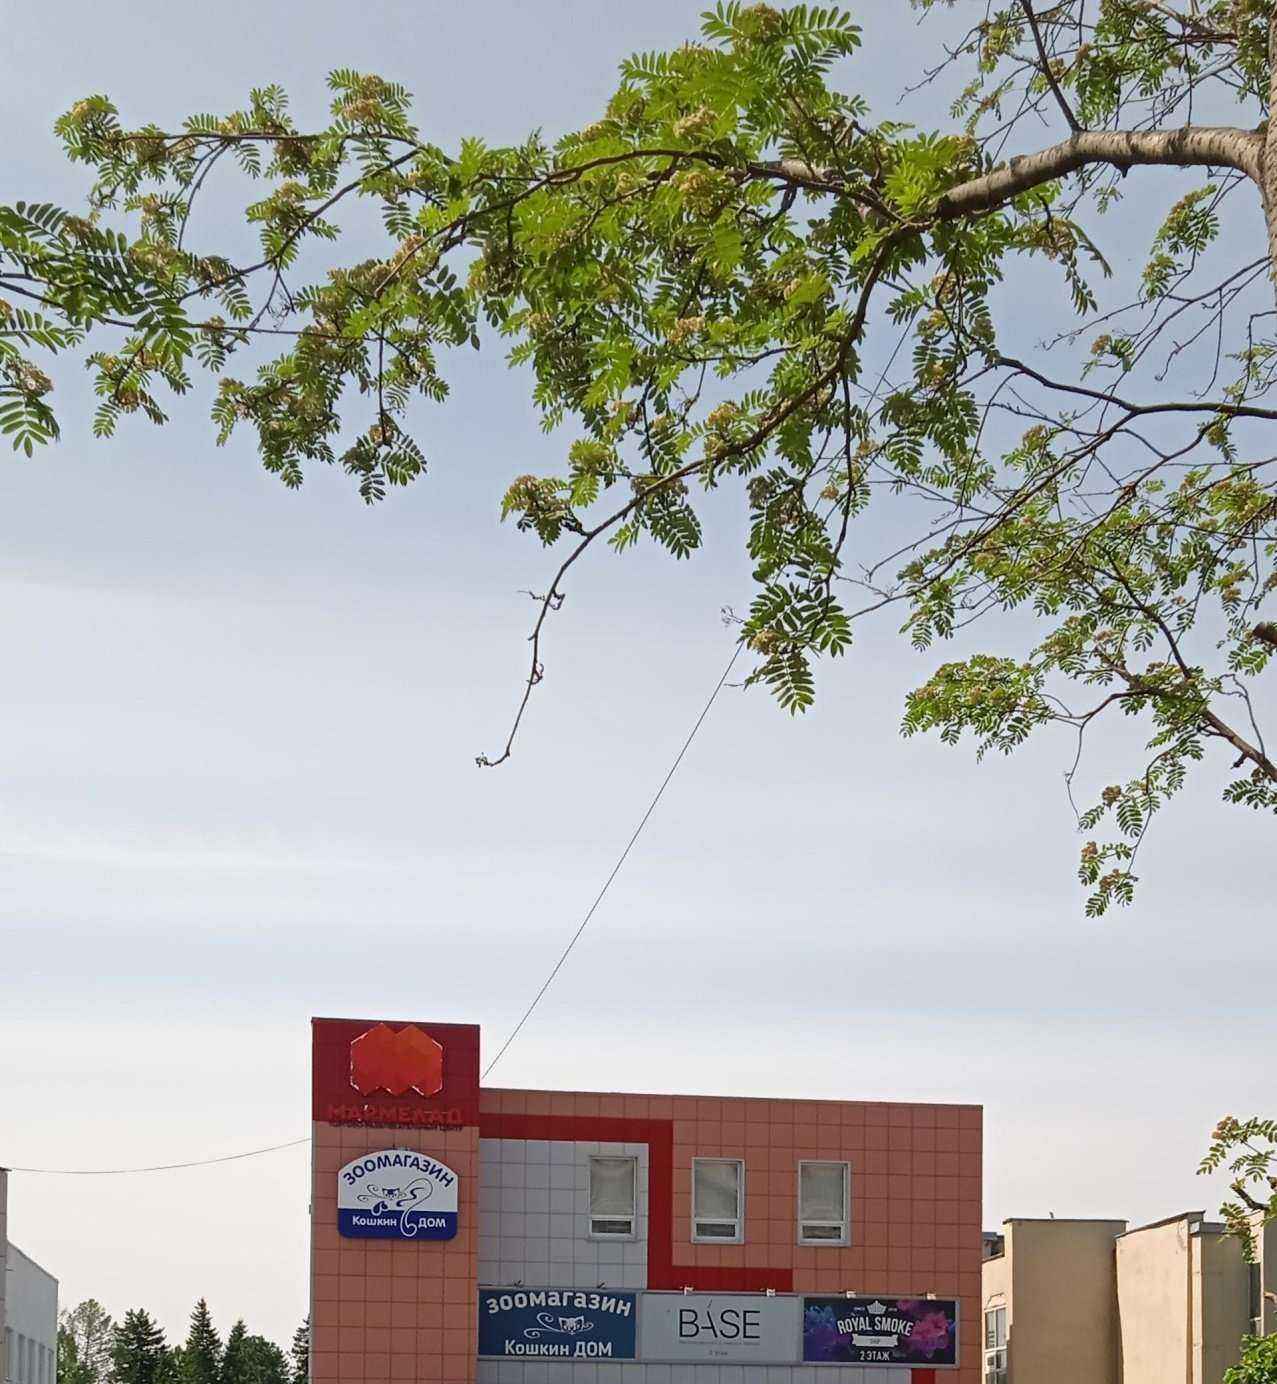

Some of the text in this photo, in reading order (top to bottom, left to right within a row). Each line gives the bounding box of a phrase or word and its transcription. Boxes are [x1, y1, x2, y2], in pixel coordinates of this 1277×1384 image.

[343, 1154, 454, 1187] ЗООМАГАЗИН
[352, 1215, 397, 1226] Кошкин
[837, 1316, 914, 1337] ROYAL SMOKE
[504, 1340, 612, 1358] Кошкин ДОМ
[860, 1351, 866, 1361] 2
[868, 1351, 890, 1361] ЭТАЖ
